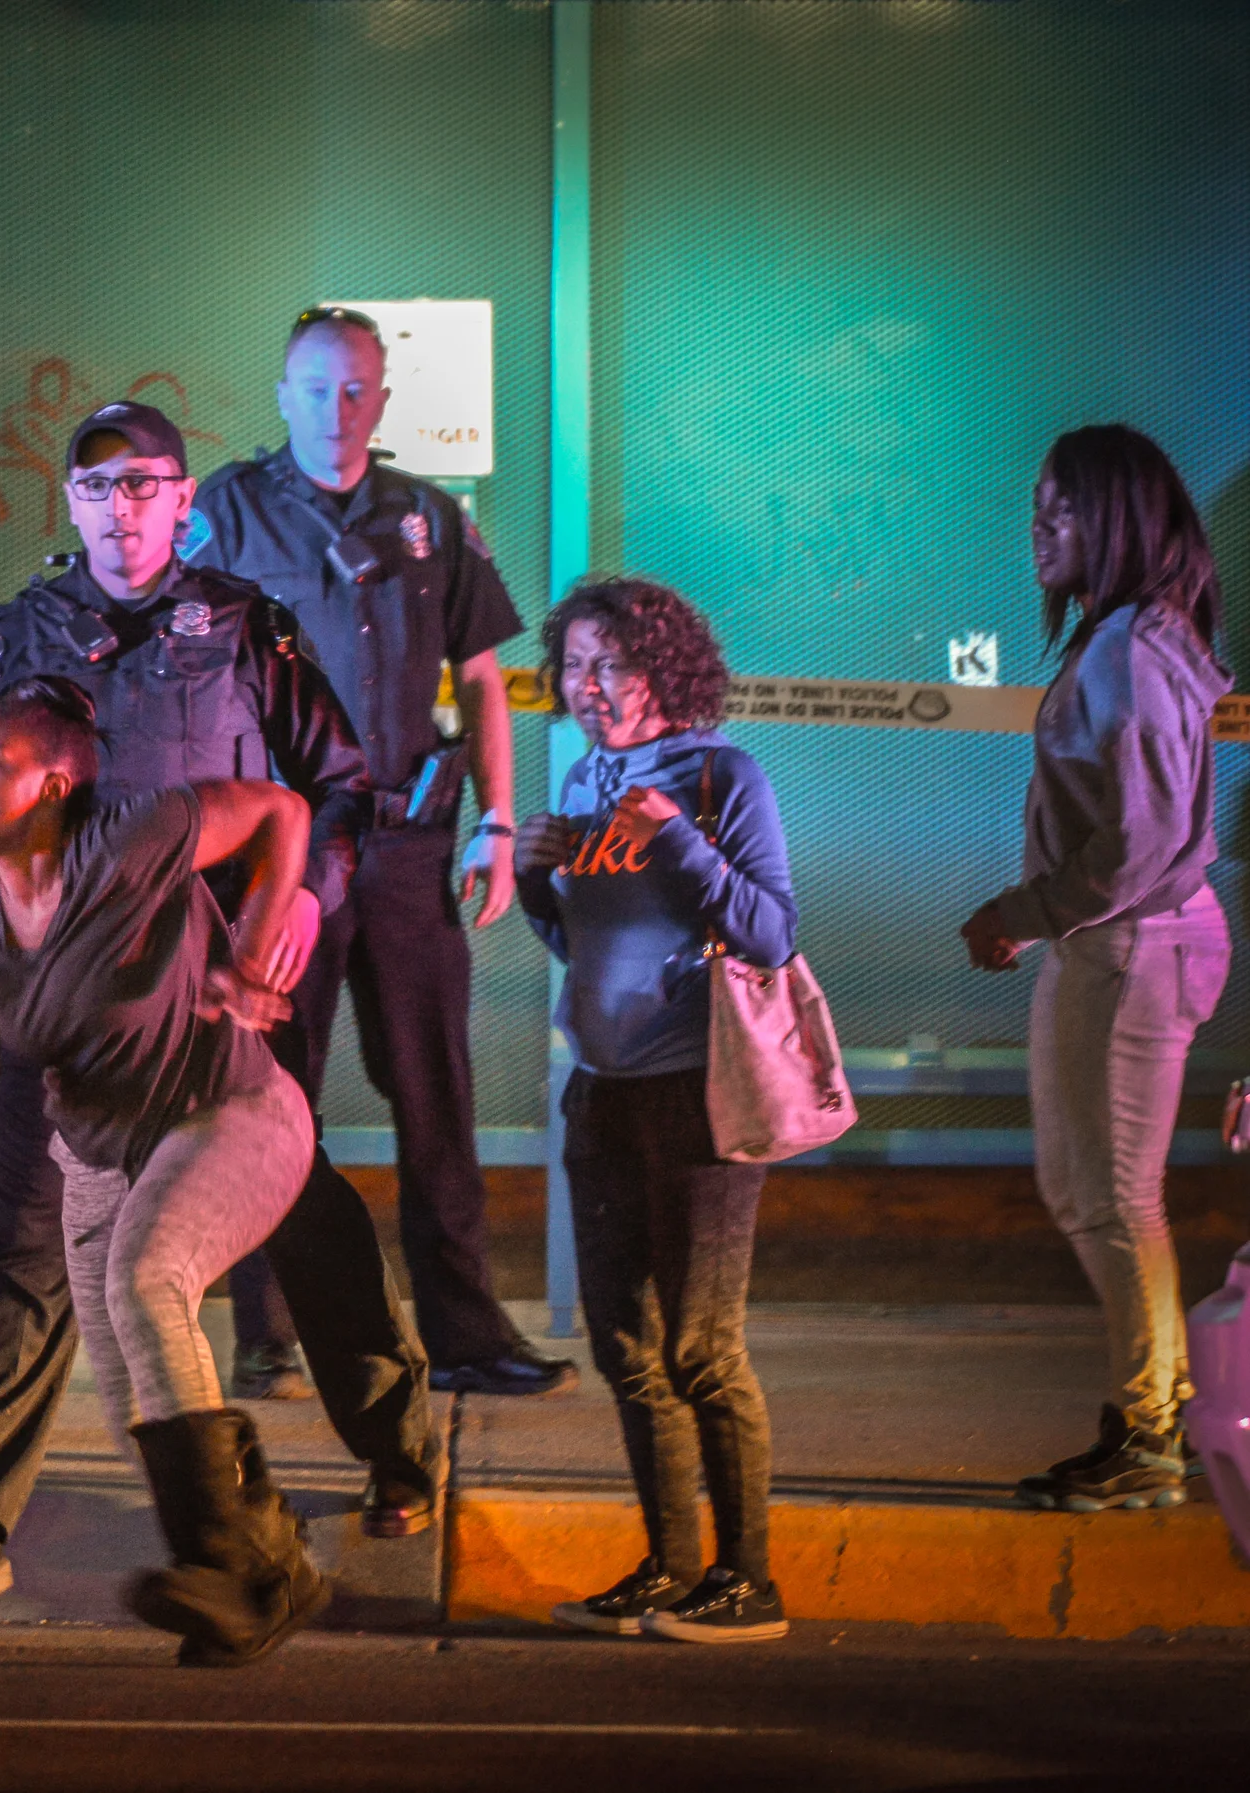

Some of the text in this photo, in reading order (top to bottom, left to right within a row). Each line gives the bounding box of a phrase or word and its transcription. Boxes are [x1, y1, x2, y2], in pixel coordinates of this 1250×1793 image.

[417, 427, 479, 444] TIGER
[754, 683, 776, 698] NO
[750, 701, 781, 716] NOT
[784, 701, 807, 717] DO
[811, 702, 845, 718] LINE
[850, 703, 905, 720] POLICE
[557, 813, 654, 877] ike
